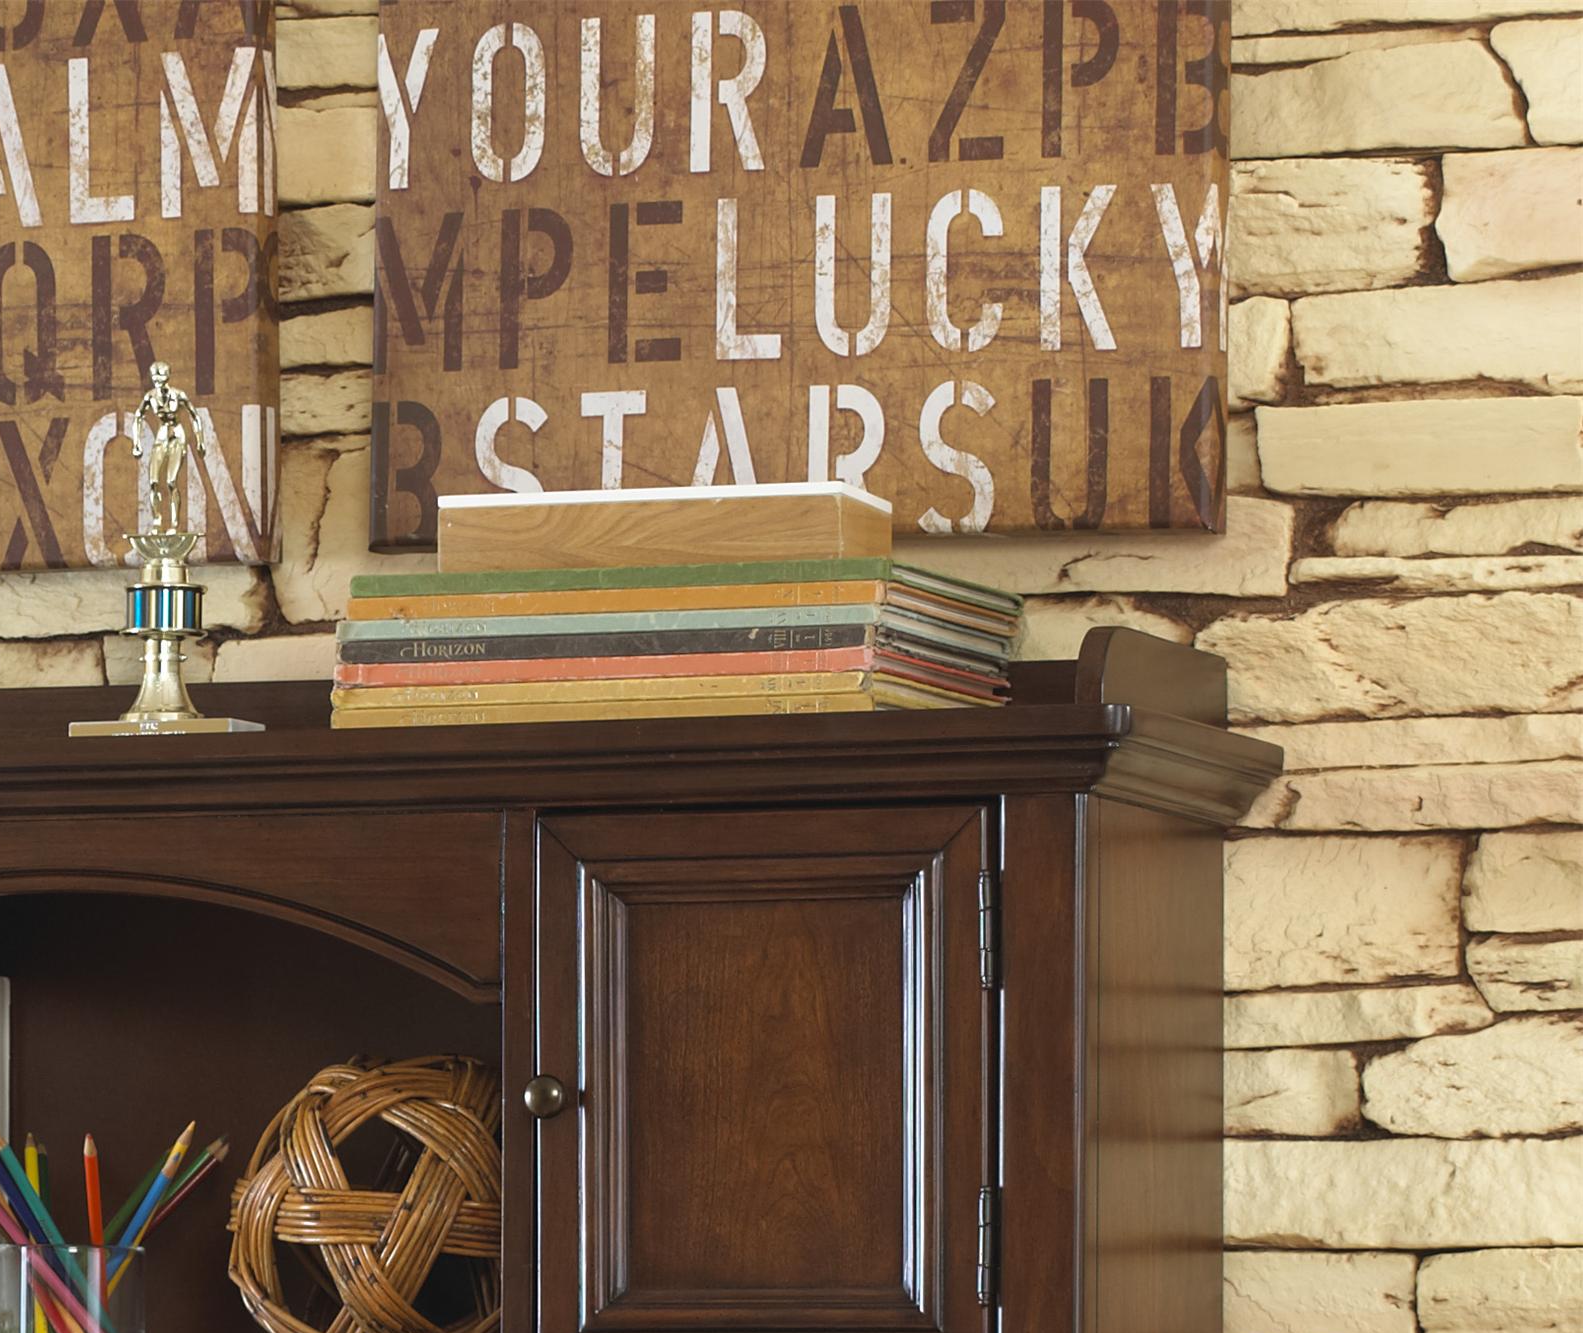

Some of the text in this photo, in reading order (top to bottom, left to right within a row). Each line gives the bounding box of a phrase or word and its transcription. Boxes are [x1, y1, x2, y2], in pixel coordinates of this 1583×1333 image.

[376, 10, 766, 190] YOUR
[715, 183, 1224, 361] LUCKY
[82, 404, 268, 567] ON
[474, 379, 996, 534] STARS
[400, 640, 486, 659] HORIZON
